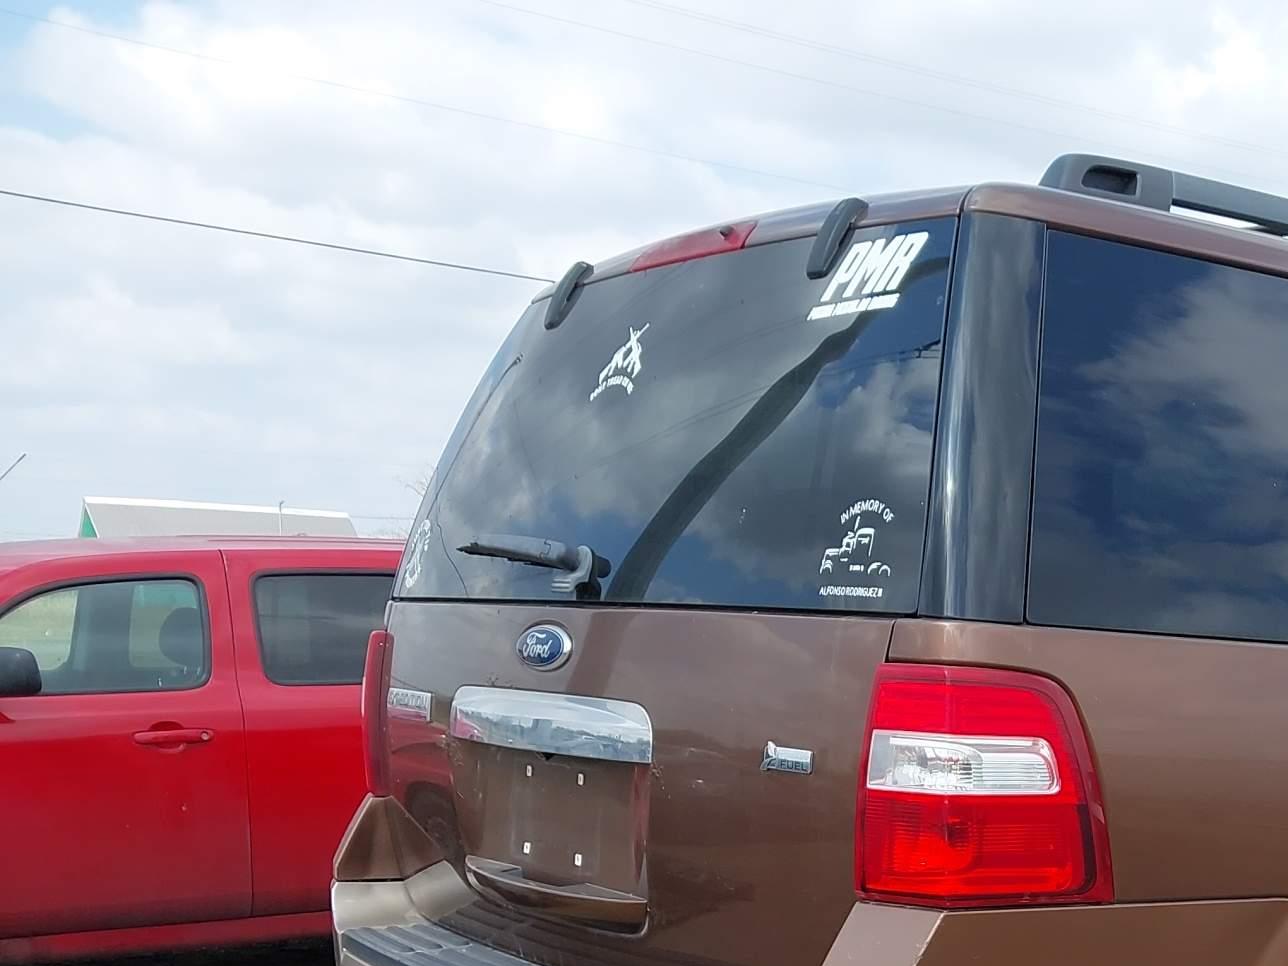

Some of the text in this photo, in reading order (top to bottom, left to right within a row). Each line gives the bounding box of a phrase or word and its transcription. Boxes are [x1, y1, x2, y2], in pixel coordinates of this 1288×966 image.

[820, 231, 929, 302] PMR
[840, 499, 895, 525] IN MEMORY OF
[819, 585, 846, 596] ALFONSO
[846, 586, 878, 599] RODRIGUEZ
[522, 631, 553, 658] Ford
[780, 759, 808, 772] FUEL
